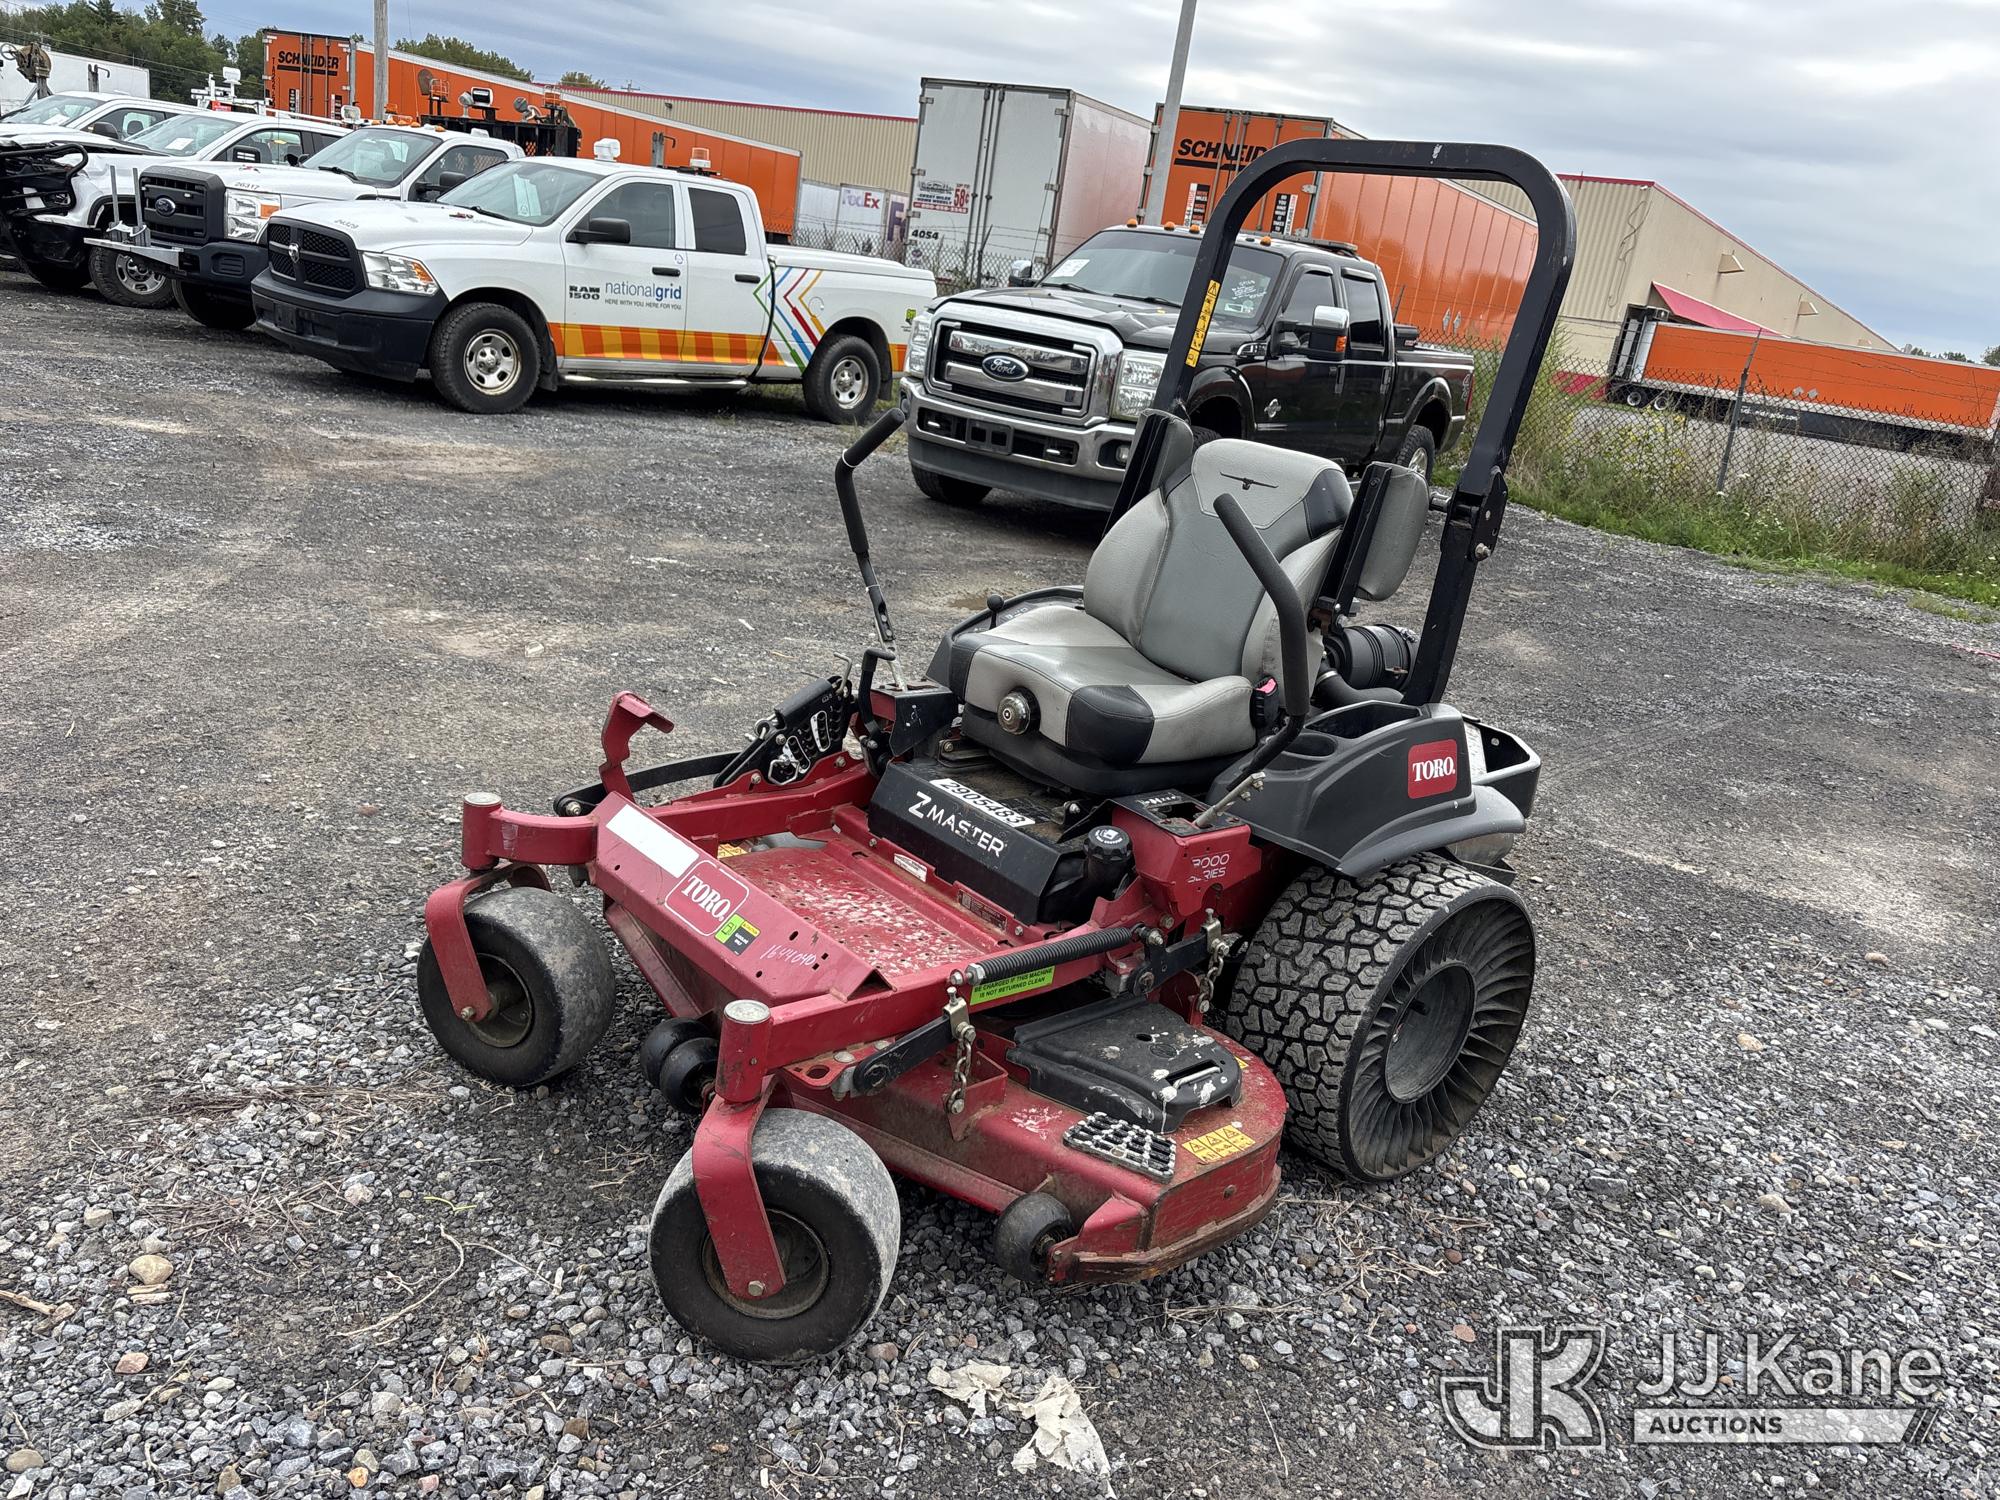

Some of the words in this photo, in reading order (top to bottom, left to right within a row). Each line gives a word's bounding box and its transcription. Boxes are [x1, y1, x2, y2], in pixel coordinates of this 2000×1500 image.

[278, 51, 339, 69] SCHNEIDER
[912, 229, 939, 240] 4054
[569, 285, 600, 293] RAM
[569, 292, 600, 300] 1500
[605, 281, 682, 301] nationalgrid
[991, 358, 1016, 375] Ford
[1412, 756, 1454, 782] TORO
[940, 782, 1027, 824] 2905483
[908, 791, 932, 819] Z
[926, 804, 1005, 858] MASTER
[681, 875, 731, 919] TORO
[983, 979, 1010, 990] CHARGED
[1016, 974, 1028, 983] THIS
[985, 988, 998, 996] NOT
[998, 981, 1027, 992] RETURNED
[1029, 977, 1046, 985] CLEAN
